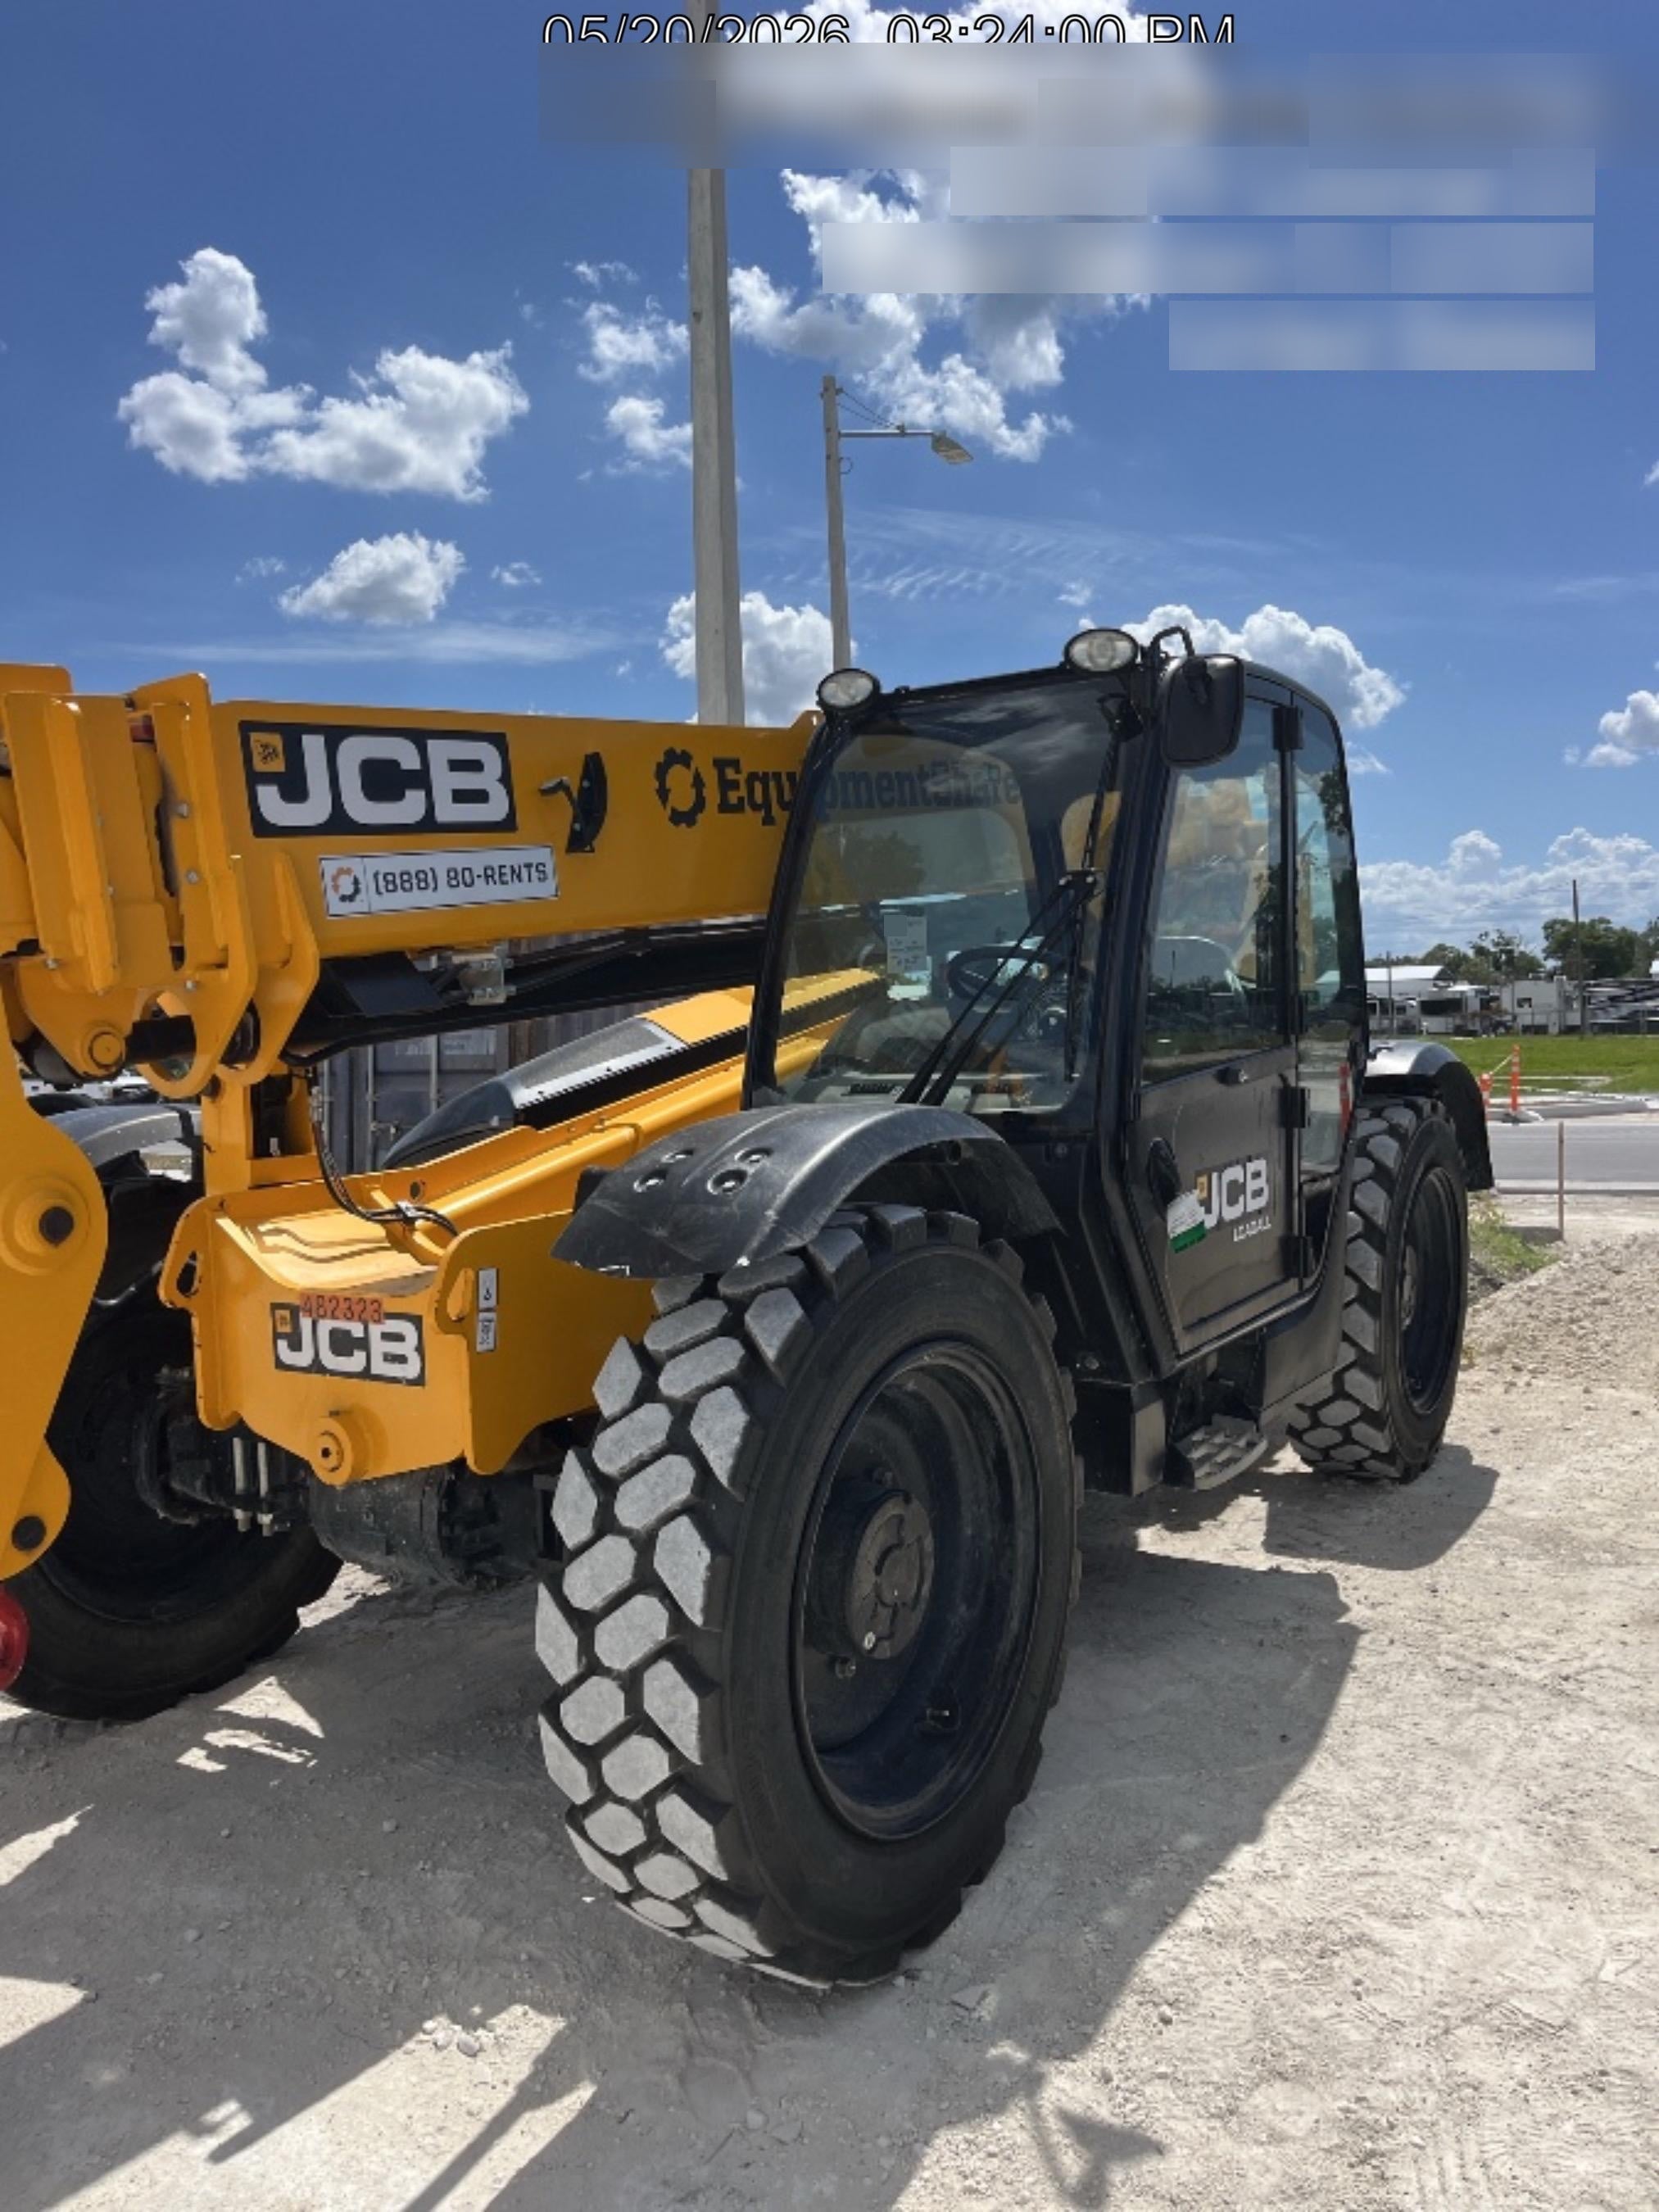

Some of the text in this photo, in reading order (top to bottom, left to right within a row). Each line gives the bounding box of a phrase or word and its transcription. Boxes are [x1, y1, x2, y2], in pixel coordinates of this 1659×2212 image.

[256, 733, 510, 827] JCB
[373, 862, 549, 895] (888) 80-RENTS
[1203, 1158, 1269, 1230] JCB
[300, 1294, 383, 1323] 482323
[277, 1315, 422, 1380] JCB
